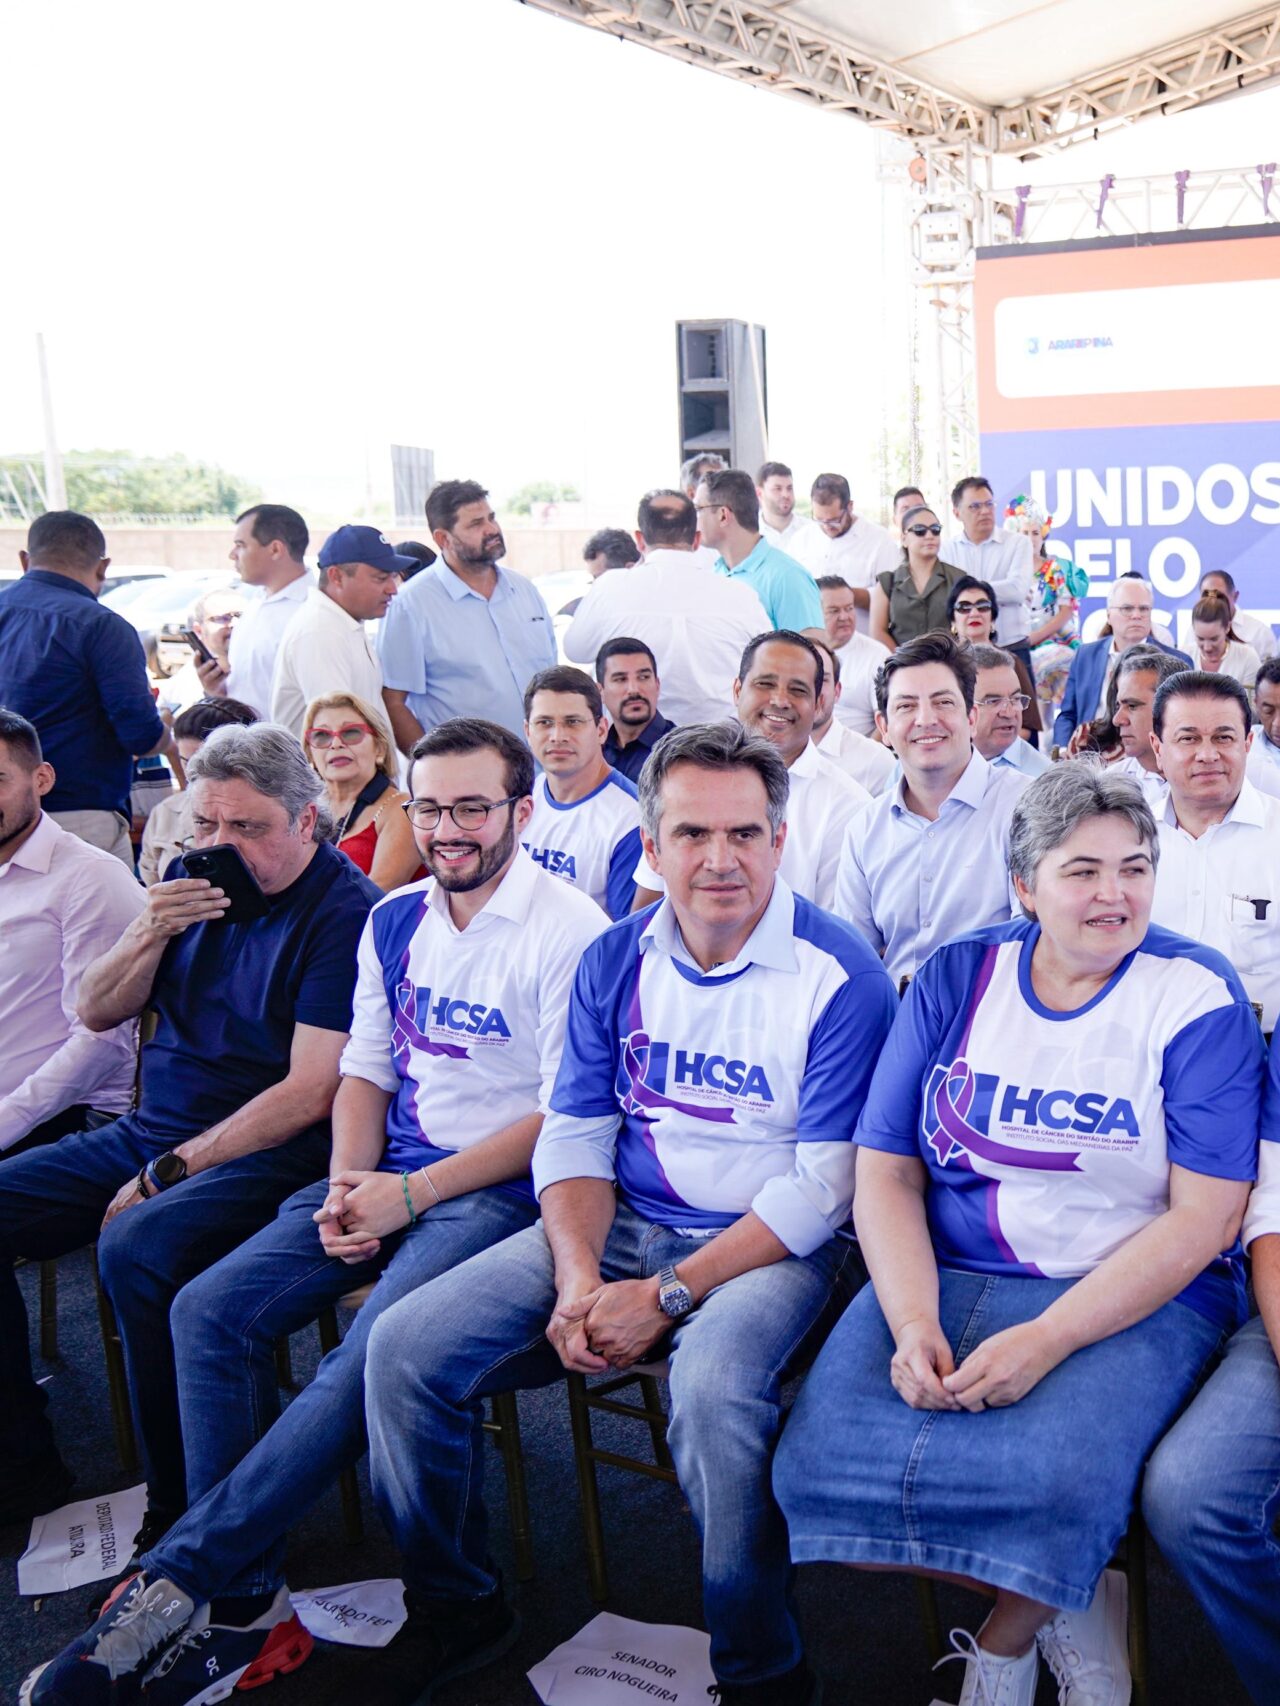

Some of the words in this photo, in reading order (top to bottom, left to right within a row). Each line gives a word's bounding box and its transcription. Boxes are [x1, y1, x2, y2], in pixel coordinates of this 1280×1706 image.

[674, 1050, 774, 1102] HCSA
[999, 1085, 1141, 1137] HCSA
[1002, 1125, 1030, 1133] HOSPITAL
[1041, 1130, 1065, 1138] CÂNCER
[1076, 1134, 1100, 1142] SERTÃO
[101, 1532, 118, 1571] FEDERAL
[574, 1665, 607, 1678] CIRO
[607, 1670, 680, 1702] NOGUEIRA
[611, 1651, 677, 1678] SENADOR
